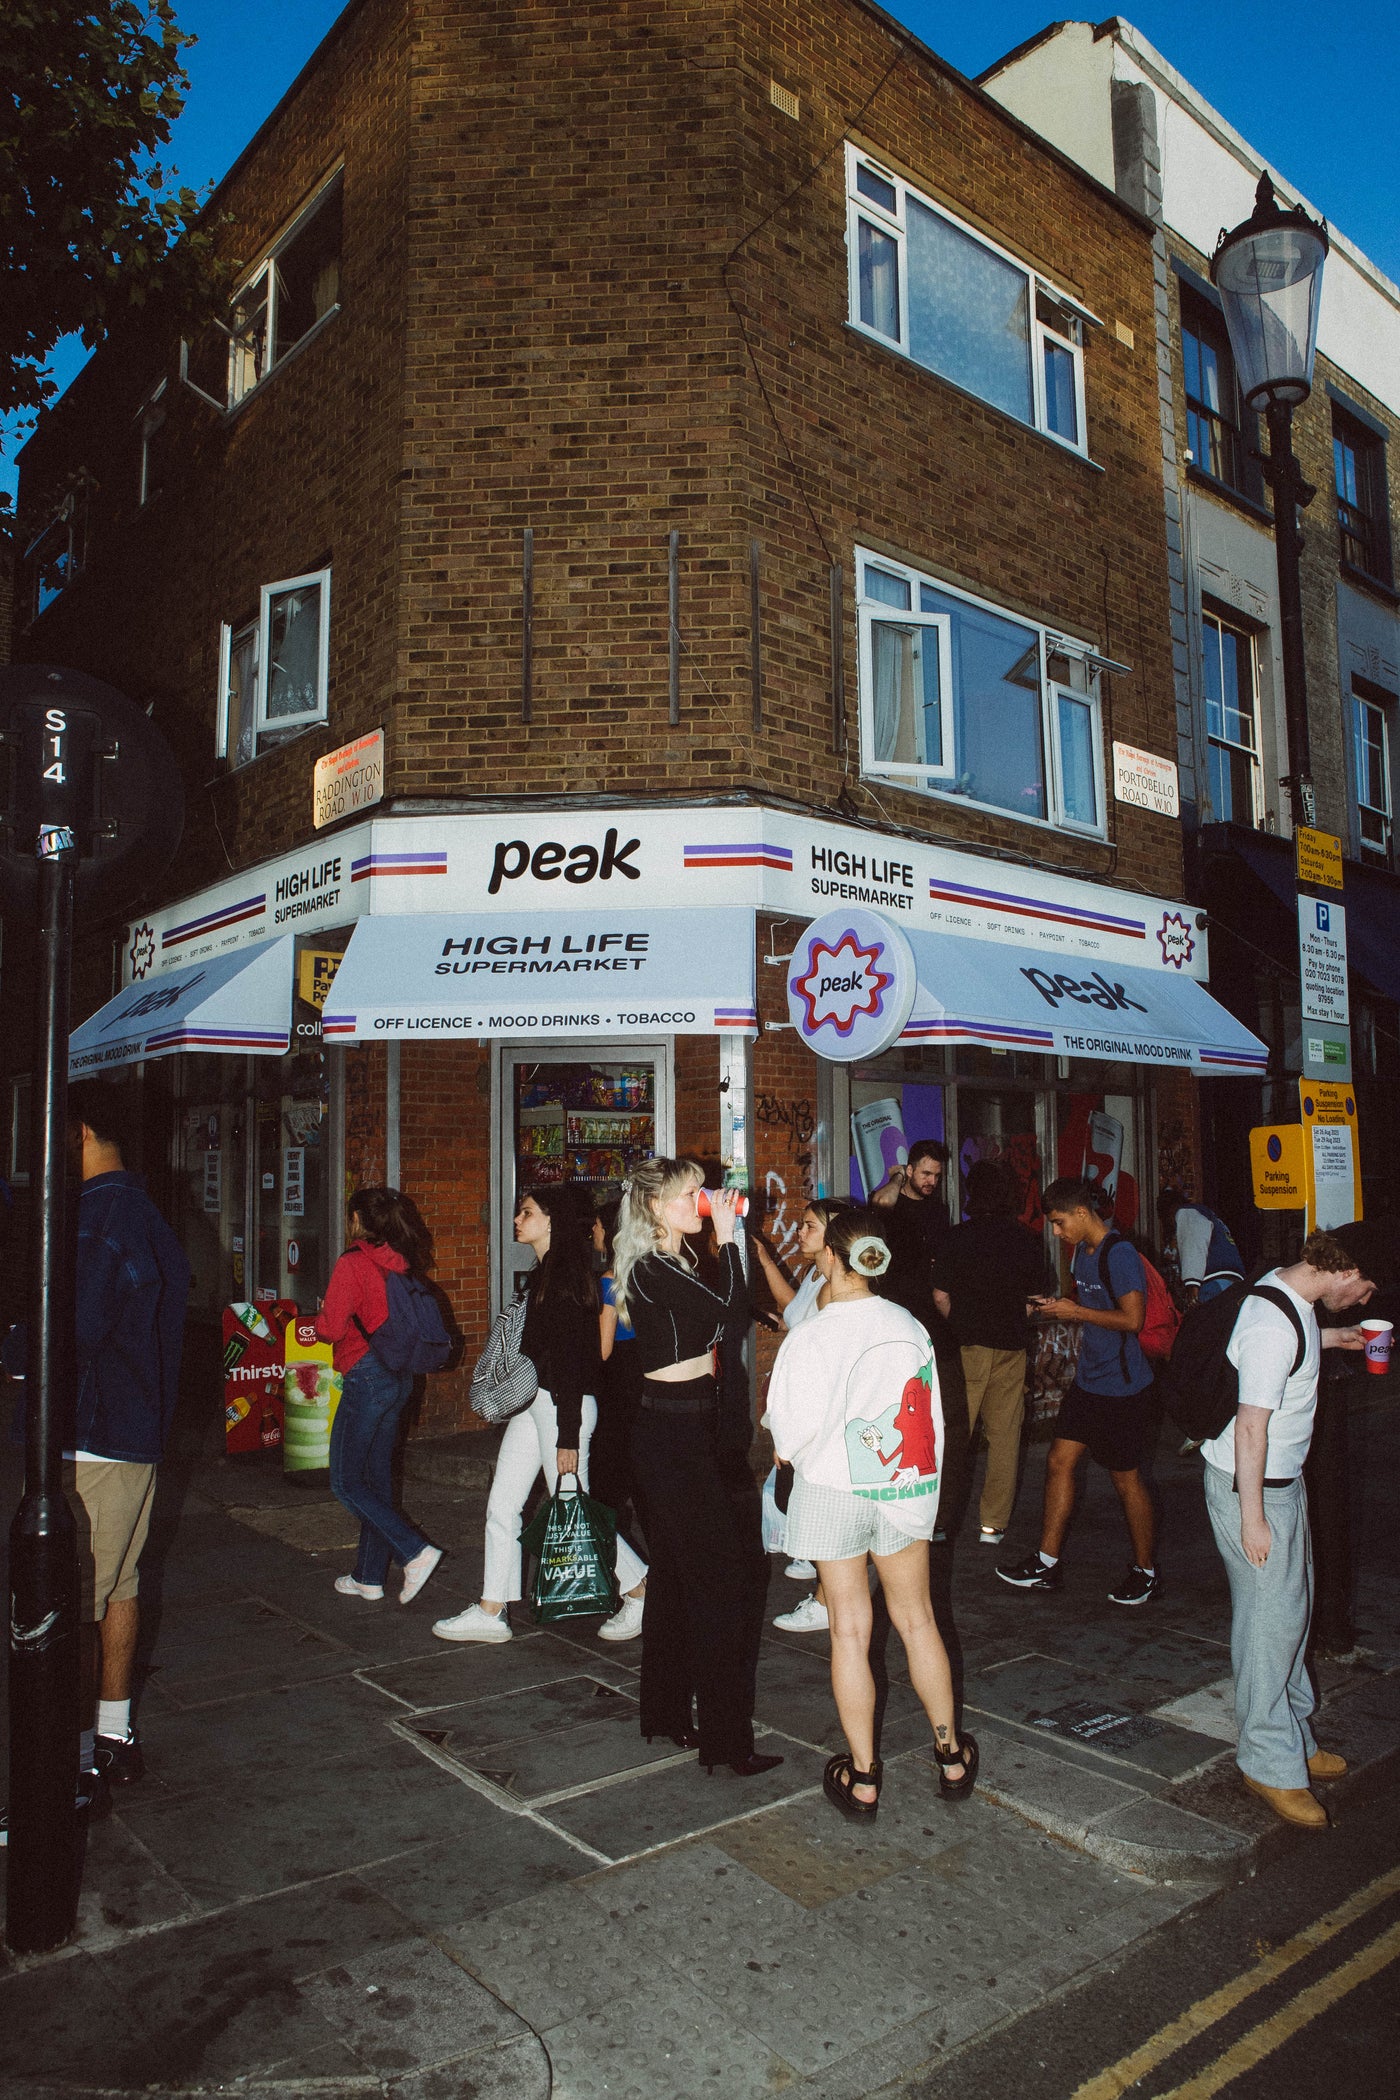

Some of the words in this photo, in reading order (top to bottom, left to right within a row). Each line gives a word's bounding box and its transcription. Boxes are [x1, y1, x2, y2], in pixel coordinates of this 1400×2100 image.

[316, 760, 381, 807] RADDINGTON
[1118, 768, 1174, 798] PORTOBELLO
[1300, 830, 1316, 844] Friday
[488, 828, 642, 895] peak
[811, 845, 867, 883] HIGH
[872, 859, 914, 888] LIFE
[1300, 856, 1324, 871] Saturday
[276, 869, 309, 903] HIGH
[312, 856, 341, 889] LIFE
[811, 878, 914, 910] SUPERMARKET
[275, 888, 341, 924] SUPERMARKET
[1320, 906, 1328, 928] P
[930, 912, 942, 922] OFF
[944, 915, 972, 926] LICENCE
[986, 922, 1002, 931] SOFT
[1004, 925, 1026, 936] DRINKS
[1039, 932, 1065, 943] PAYPOINT
[1078, 938, 1100, 950] TOBACCO
[1310, 932, 1320, 942] Mon
[1324, 936, 1337, 948] Thurs
[442, 936, 552, 957] HIGH
[561, 933, 650, 954] LIFE
[1167, 934, 1185, 947] peak
[1302, 943, 1314, 954] 8.30
[1315, 948, 1322, 956] am
[1326, 950, 1337, 959] 6.30
[1338, 954, 1345, 962] pm
[434, 958, 647, 976] SUPERMARKET
[1308, 958, 1317, 970] Pay
[1318, 960, 1325, 970] by
[1326, 963, 1341, 974] phone
[820, 970, 863, 998] peak
[1020, 967, 1149, 1014] peak
[1306, 982, 1324, 994] quoting
[1326, 984, 1345, 996] location
[374, 1018, 406, 1030] OFF
[407, 1016, 472, 1030] LICENCE
[488, 1015, 539, 1028] MOOD
[542, 1014, 600, 1026] DRINKS
[616, 1012, 696, 1025] TOBACCO
[1307, 1005, 1318, 1015] Max
[1318, 1008, 1329, 1019] stay
[1334, 1010, 1345, 1020] hour
[80, 1052, 104, 1067] ORIGINAL
[105, 1045, 122, 1060] MOOD
[122, 1041, 143, 1058] DRINK
[1064, 1035, 1085, 1050] THE
[1086, 1038, 1134, 1055] ORIGINAL
[1134, 1043, 1164, 1058] MOOD
[1164, 1046, 1192, 1060] DRINK
[1319, 1088, 1338, 1099] Parking
[1316, 1099, 1344, 1108] Suspension
[871, 1115, 892, 1126] ORIGINAL
[1318, 1114, 1326, 1123] No
[1326, 1114, 1346, 1124] Loading
[1264, 1171, 1290, 1184] Parking
[1260, 1184, 1298, 1196] Suspension
[229, 1363, 286, 1382] Thirsty
[566, 1530, 591, 1538] VALUE
[574, 1522, 590, 1530] NOT
[545, 1564, 596, 1580] VALUE
